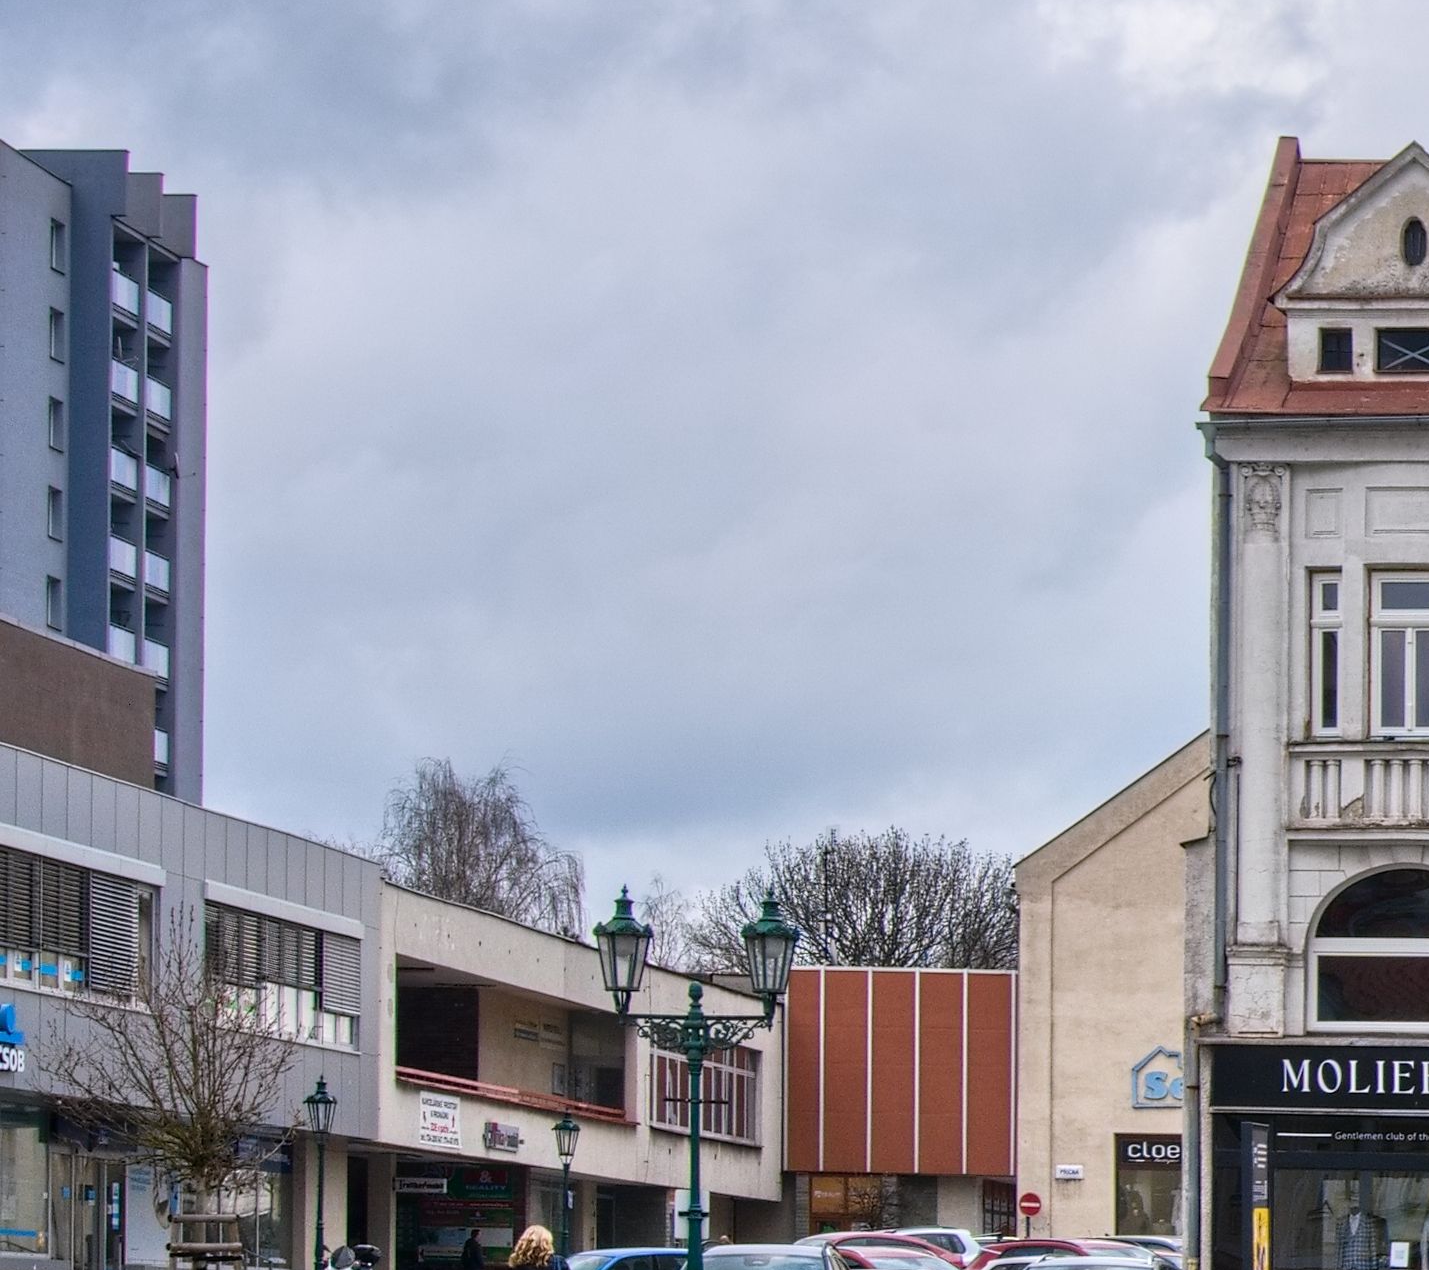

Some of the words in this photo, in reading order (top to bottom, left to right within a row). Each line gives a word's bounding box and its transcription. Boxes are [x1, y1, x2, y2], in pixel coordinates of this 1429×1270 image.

[1334, 1131, 1383, 1141] Gentlemen
[1385, 1132, 1405, 1141] club
[1407, 1133, 1416, 1141] of
